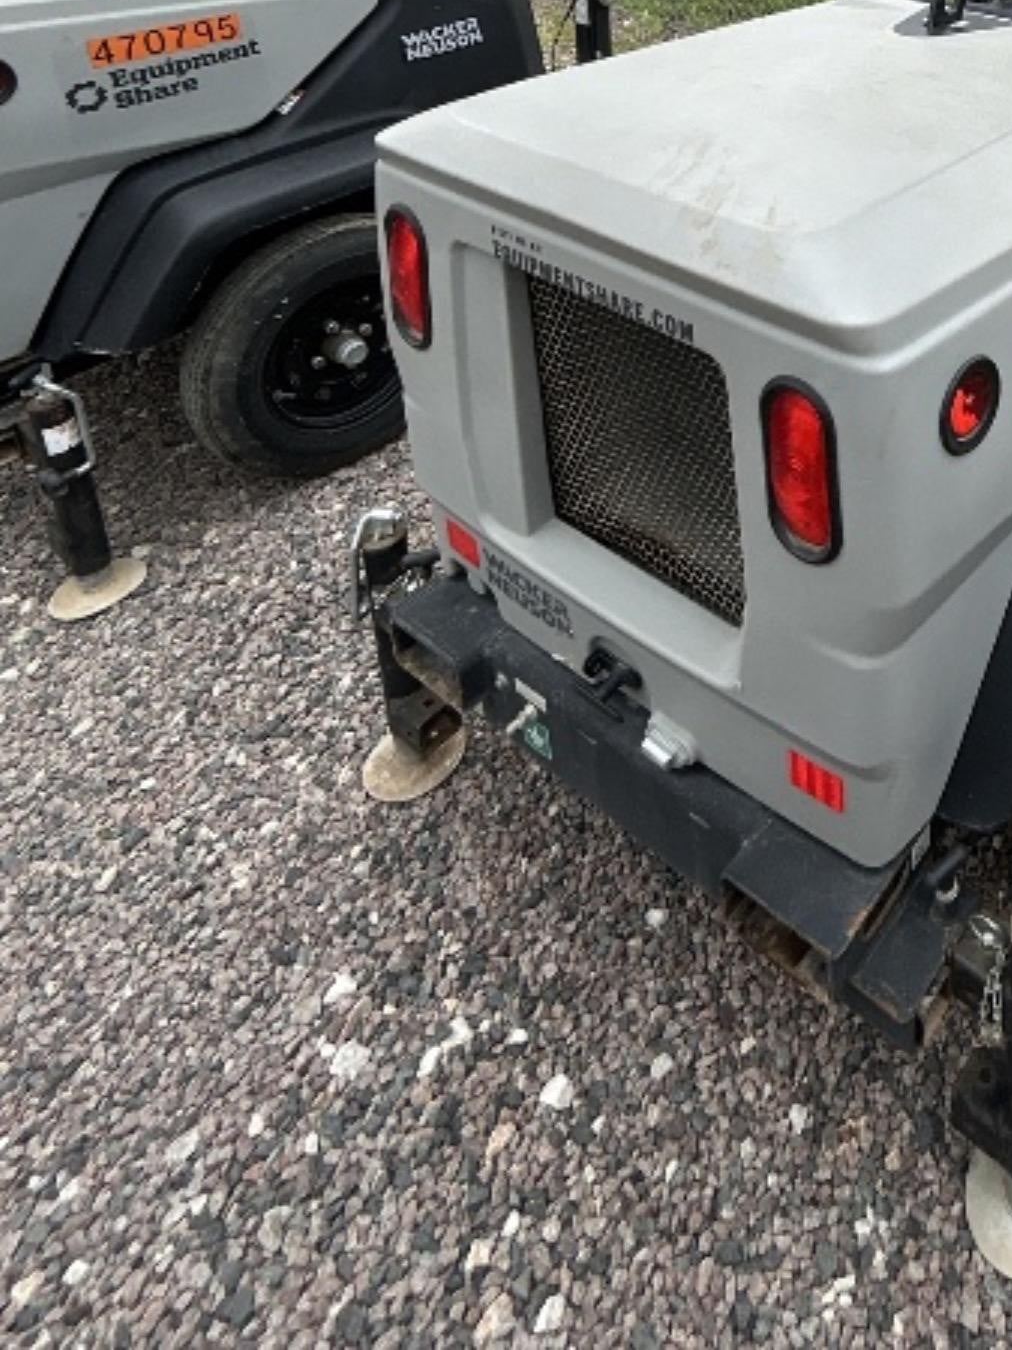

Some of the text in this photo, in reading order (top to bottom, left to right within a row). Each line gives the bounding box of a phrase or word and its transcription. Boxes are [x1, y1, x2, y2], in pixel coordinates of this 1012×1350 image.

[91, 15, 239, 66] 470795
[108, 39, 261, 89] Equipment
[114, 75, 199, 111] Share
